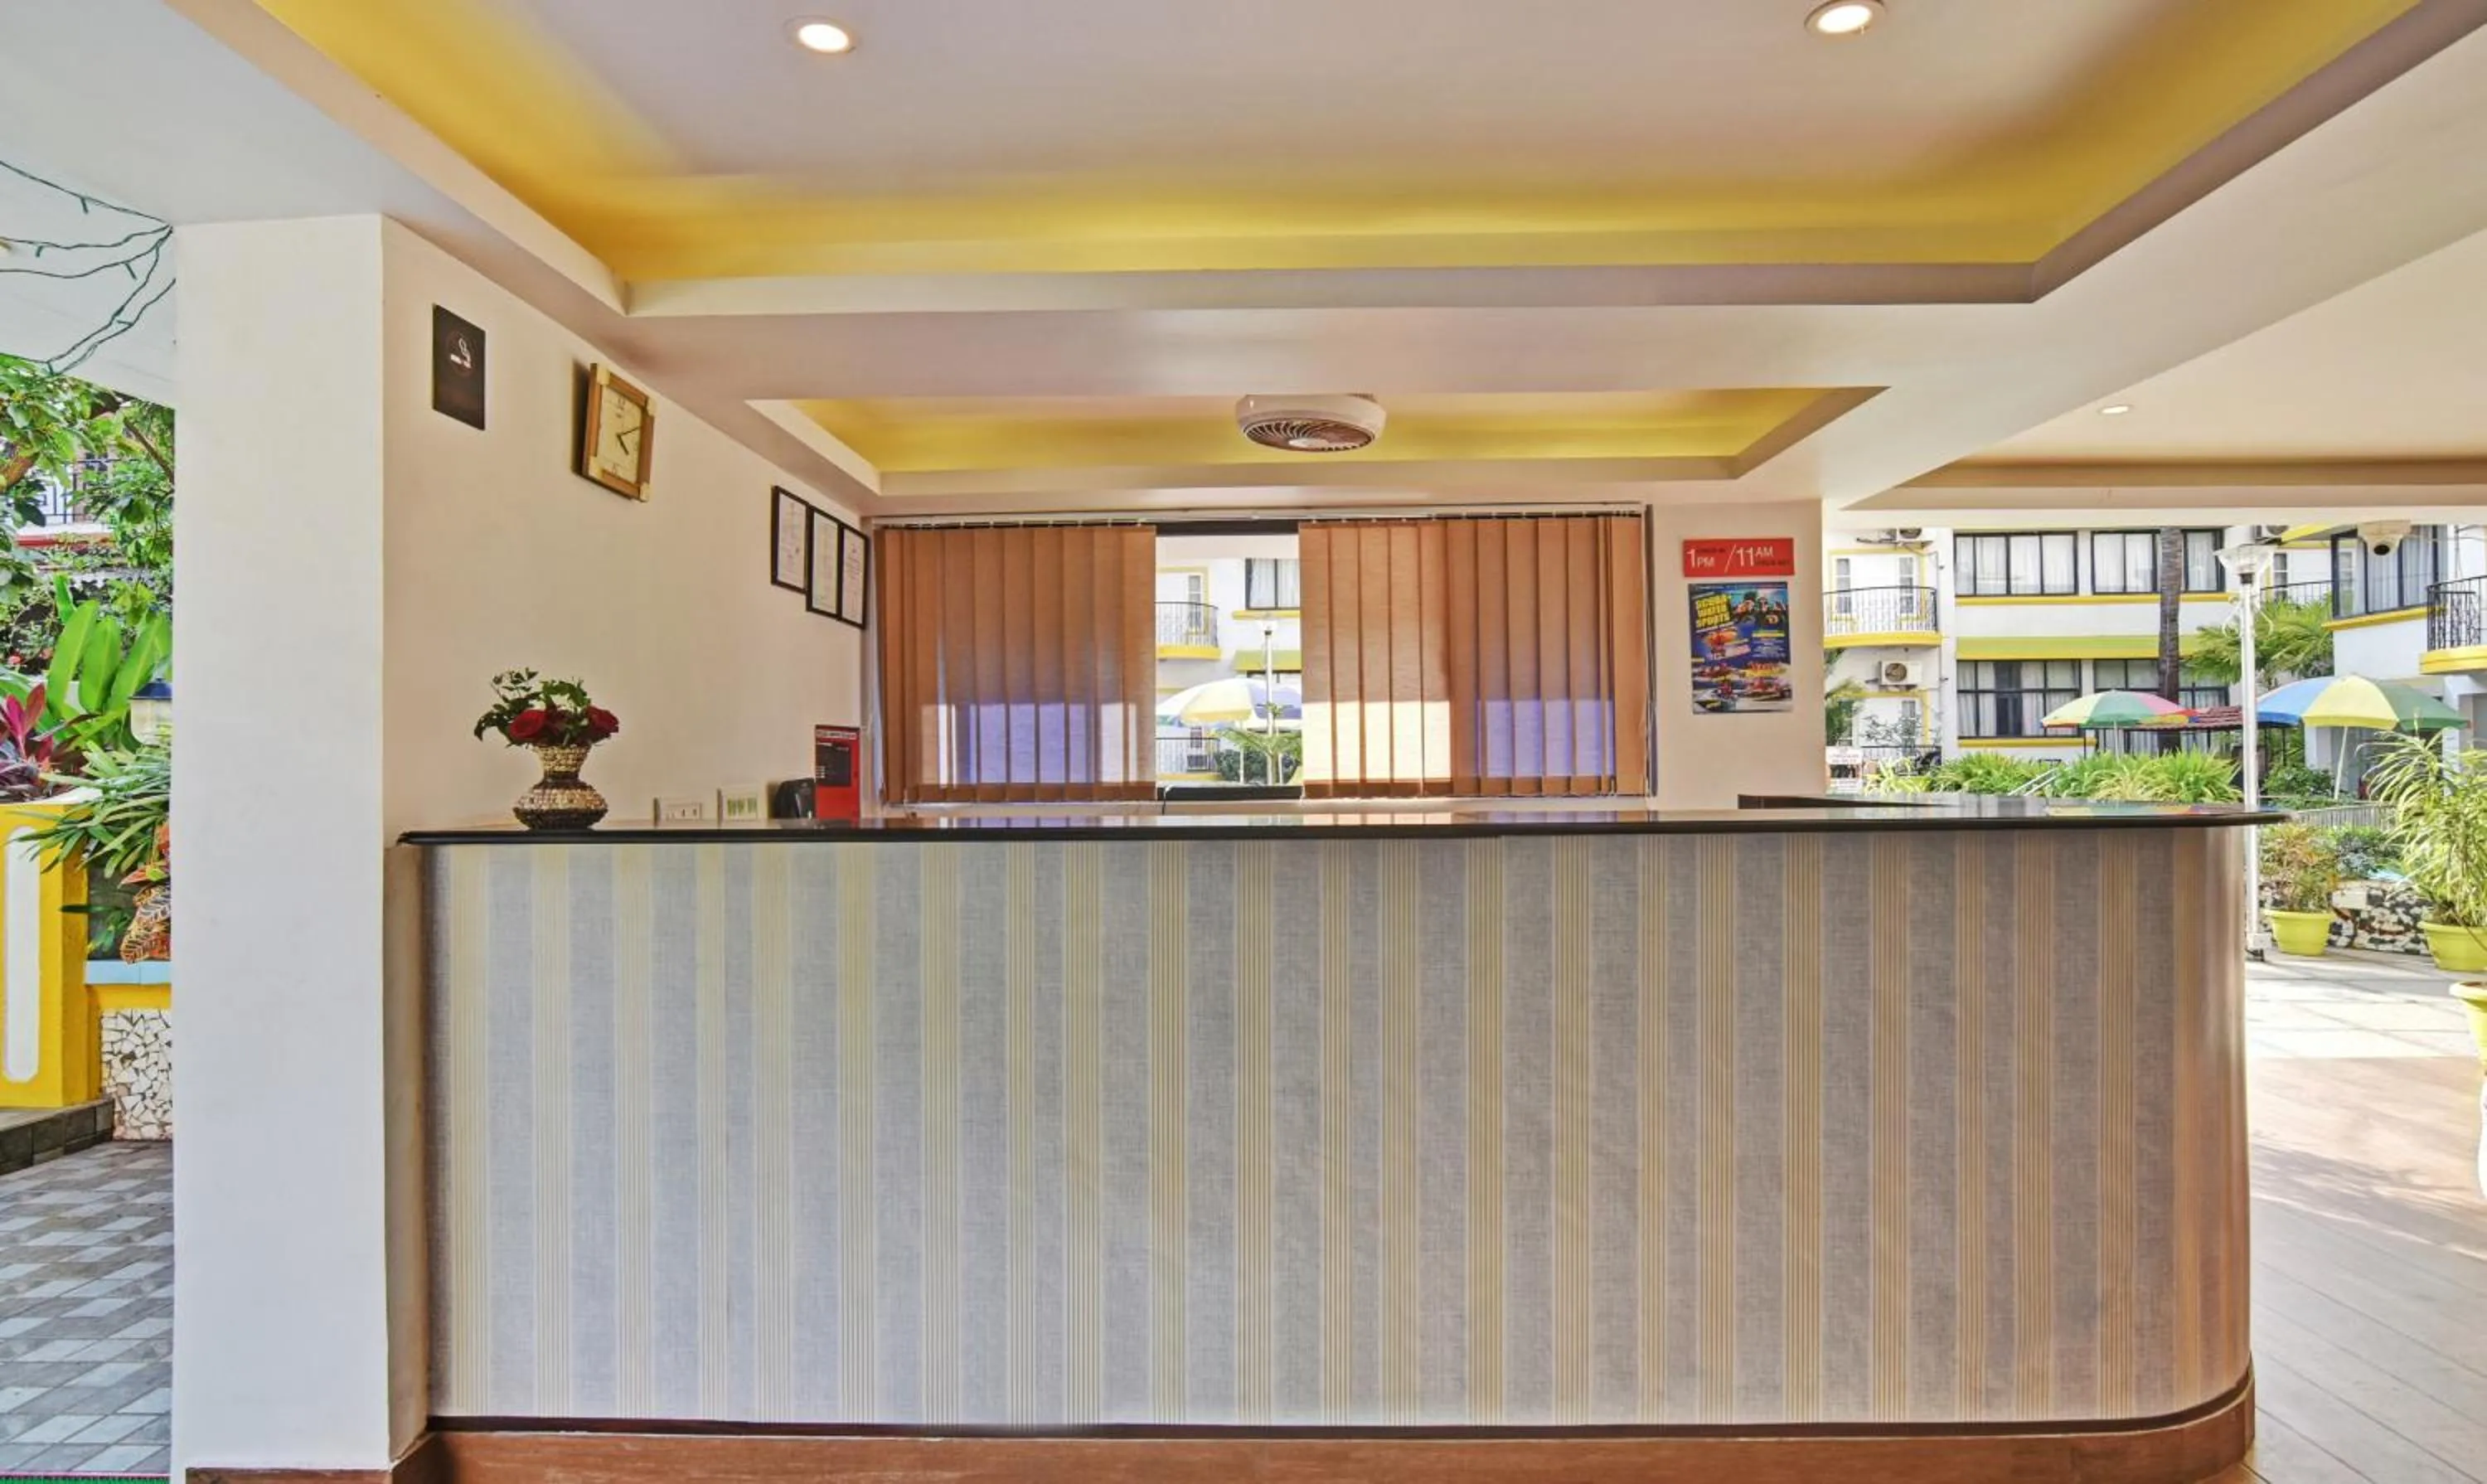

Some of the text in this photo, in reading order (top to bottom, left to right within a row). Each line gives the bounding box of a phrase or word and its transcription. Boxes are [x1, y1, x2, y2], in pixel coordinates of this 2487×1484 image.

[1686, 548, 1695, 568] 1
[1697, 556, 1714, 568] PM
[1736, 546, 1754, 566] 11
[1755, 546, 1773, 557] AM
